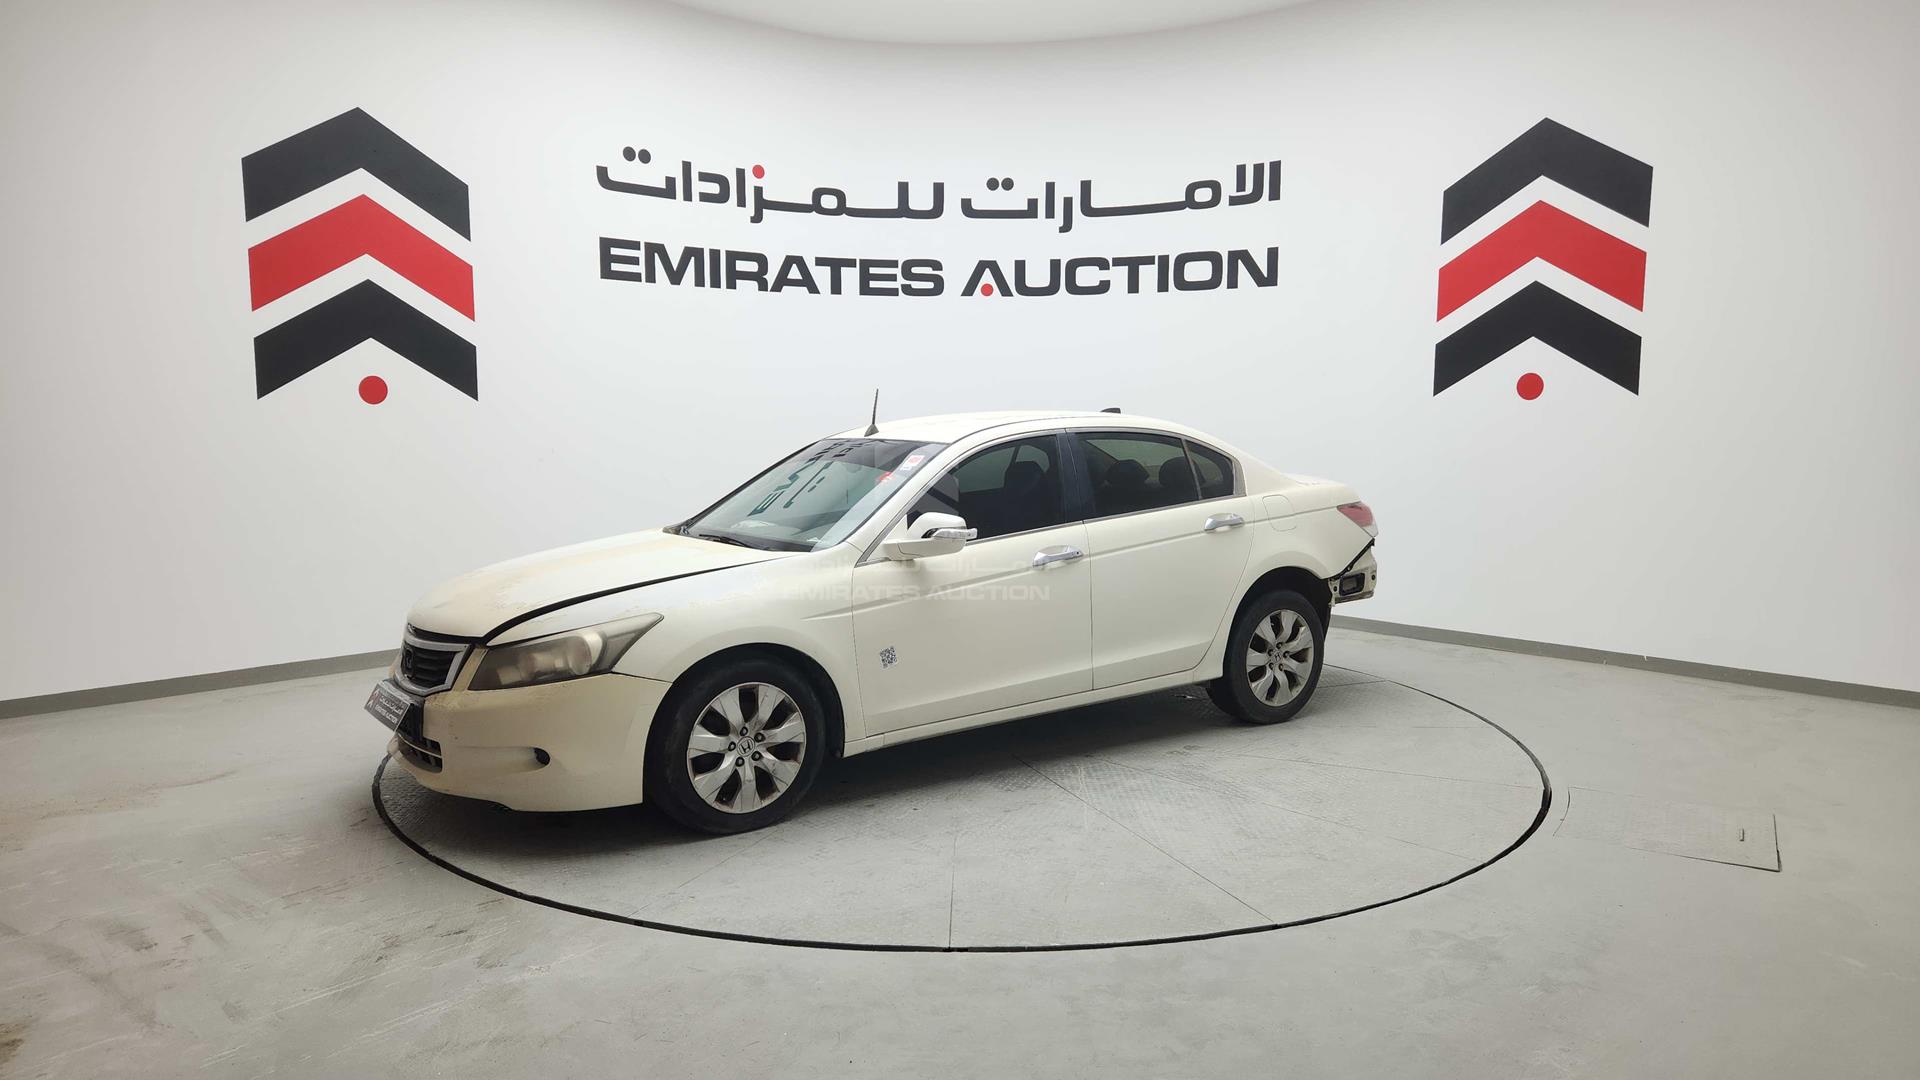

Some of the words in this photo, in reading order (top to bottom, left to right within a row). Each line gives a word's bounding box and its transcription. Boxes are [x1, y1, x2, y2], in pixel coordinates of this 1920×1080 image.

[596, 147, 945, 223] للمزادات
[600, 237, 945, 297] EMIRATES
[961, 247, 1279, 297] AUCTION
